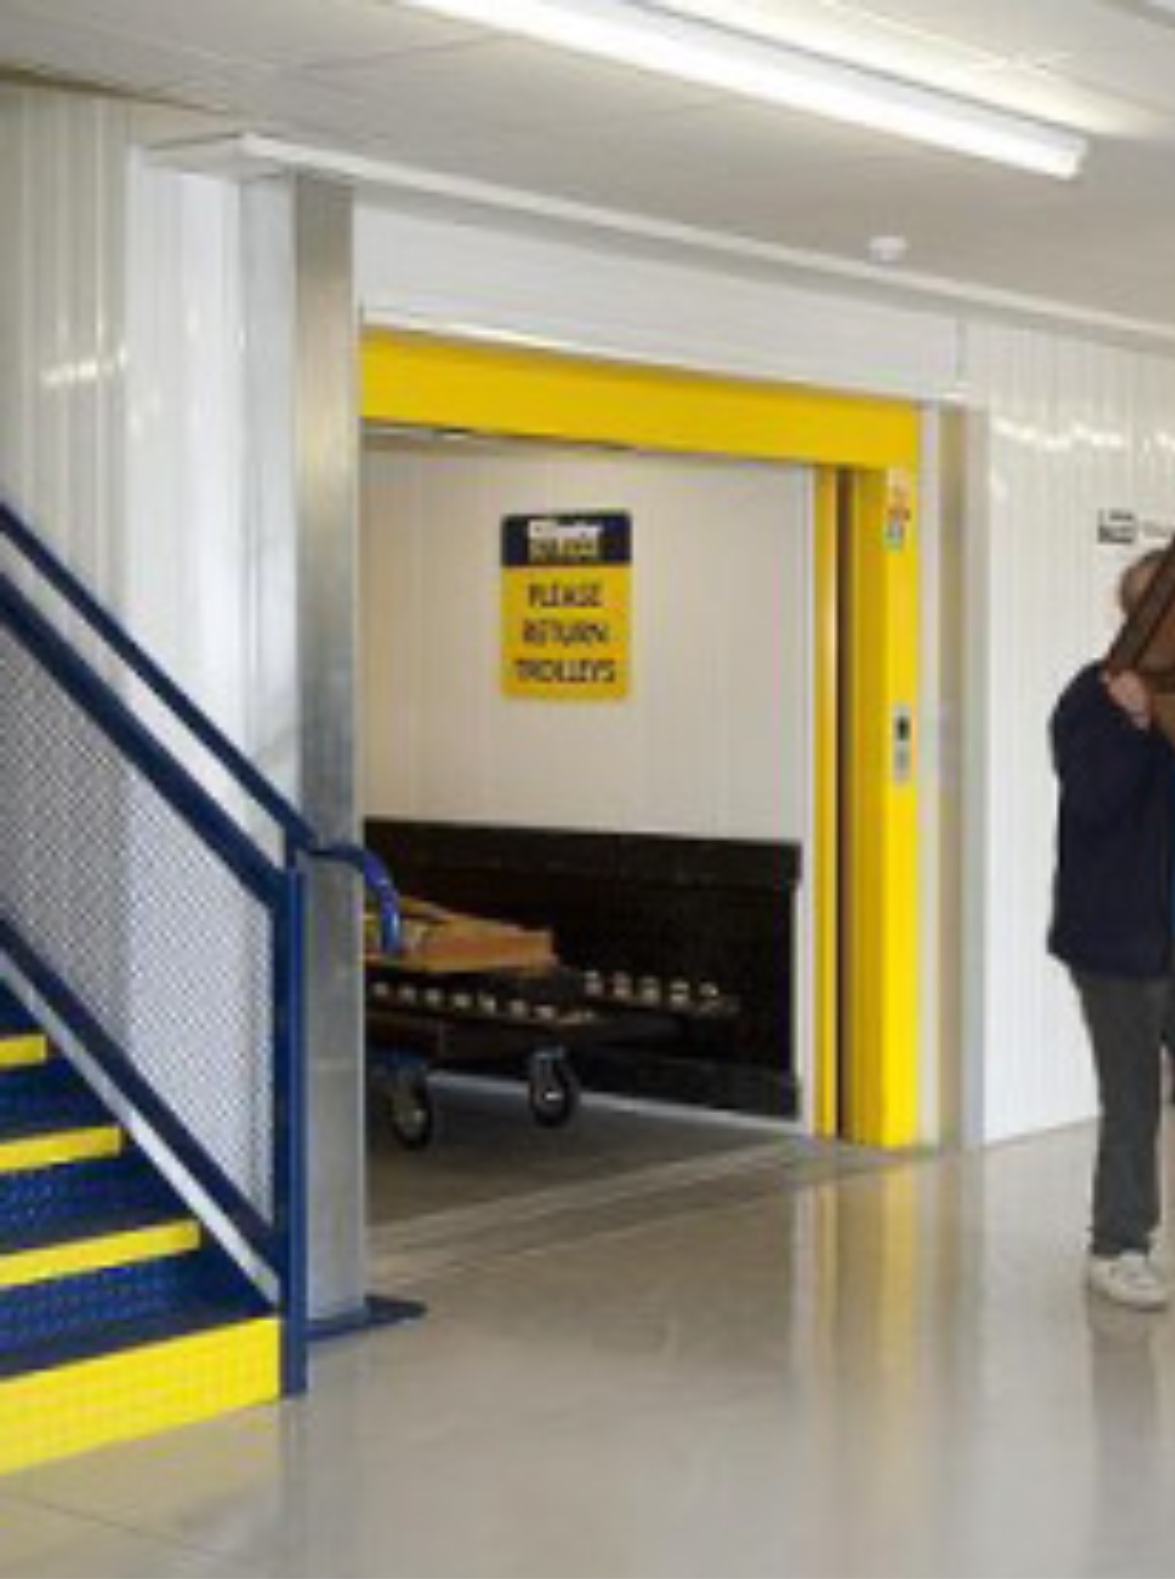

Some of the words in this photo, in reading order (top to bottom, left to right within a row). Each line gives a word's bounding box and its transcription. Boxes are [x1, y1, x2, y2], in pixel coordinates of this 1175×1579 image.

[528, 583, 603, 608] PLEASE
[523, 619, 609, 646] RETURN
[515, 658, 616, 683] TROLLEYS
